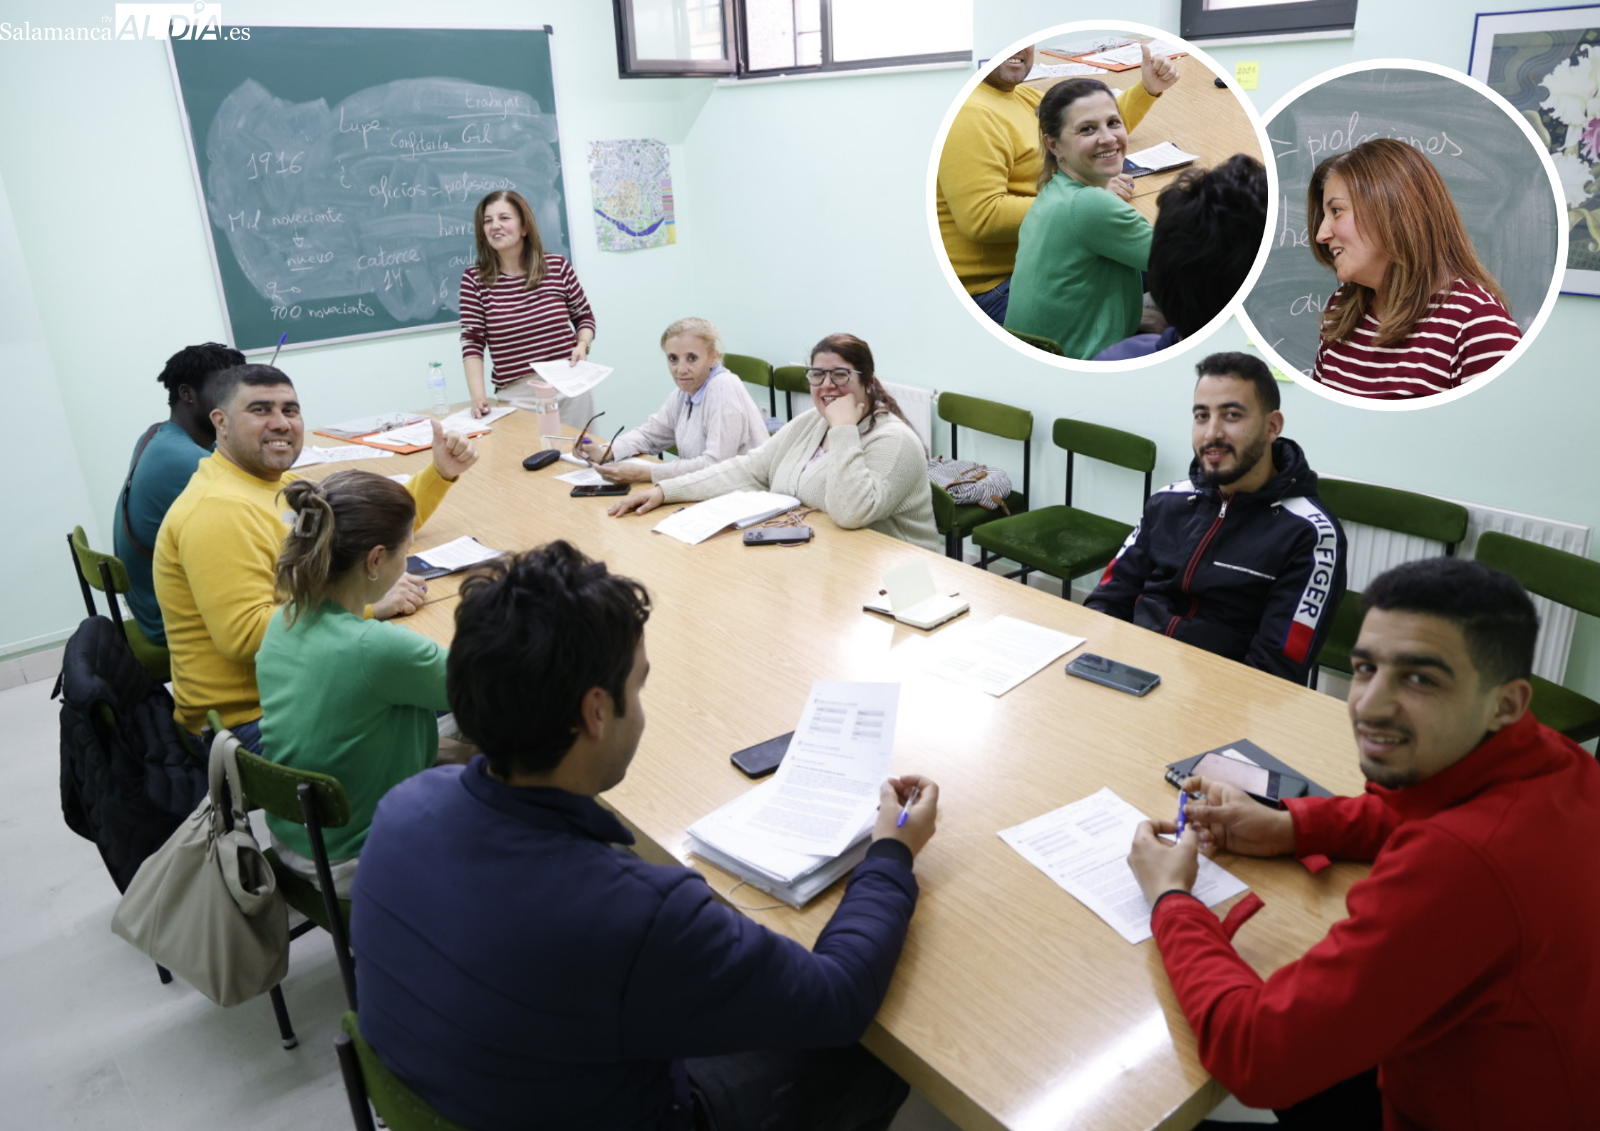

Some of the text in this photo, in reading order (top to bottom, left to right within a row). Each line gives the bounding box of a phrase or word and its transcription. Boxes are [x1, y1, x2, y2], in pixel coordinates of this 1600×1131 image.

[461, 123, 492, 144] Gil
[246, 150, 304, 180] 1916
[368, 174, 427, 208] oficios
[228, 209, 261, 232] Mil
[357, 245, 421, 270] catorce
[270, 305, 302, 320] 900
[1298, 512, 1336, 619] HILFIGER
